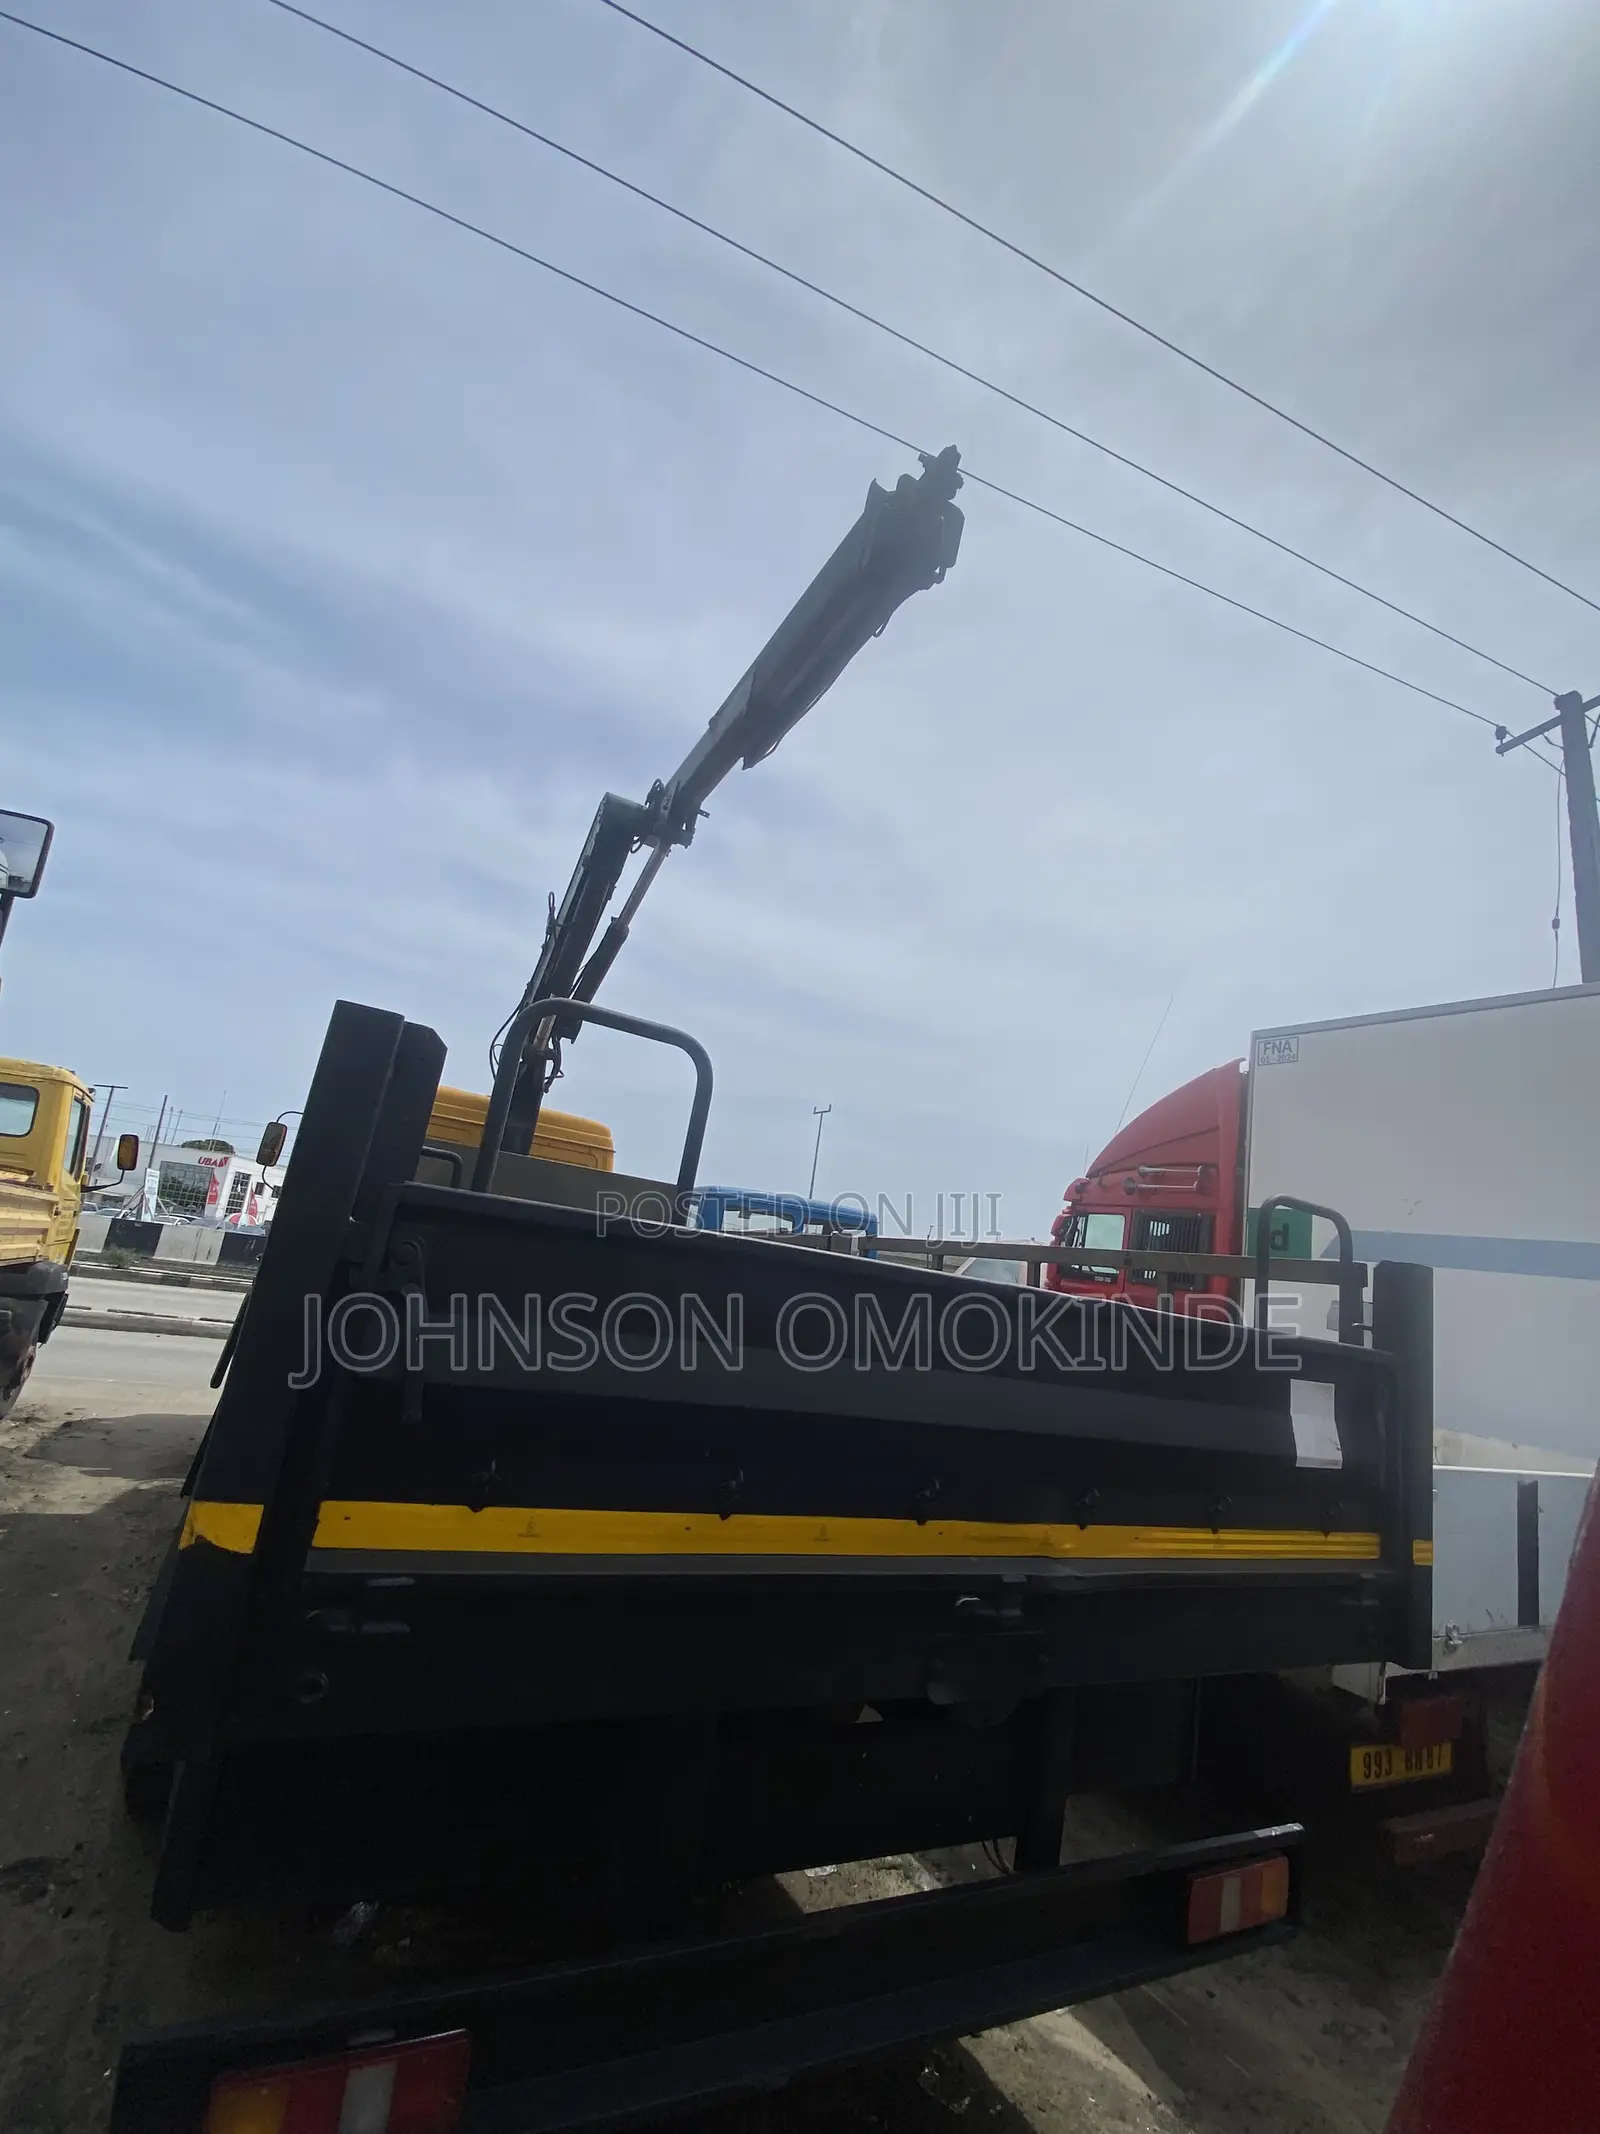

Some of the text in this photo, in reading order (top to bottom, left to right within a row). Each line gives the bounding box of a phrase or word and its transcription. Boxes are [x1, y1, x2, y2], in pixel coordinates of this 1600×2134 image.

[1264, 1040, 1292, 1055] FNA
[198, 1157, 219, 1167] UBA
[1363, 1748, 1392, 1779] 993
